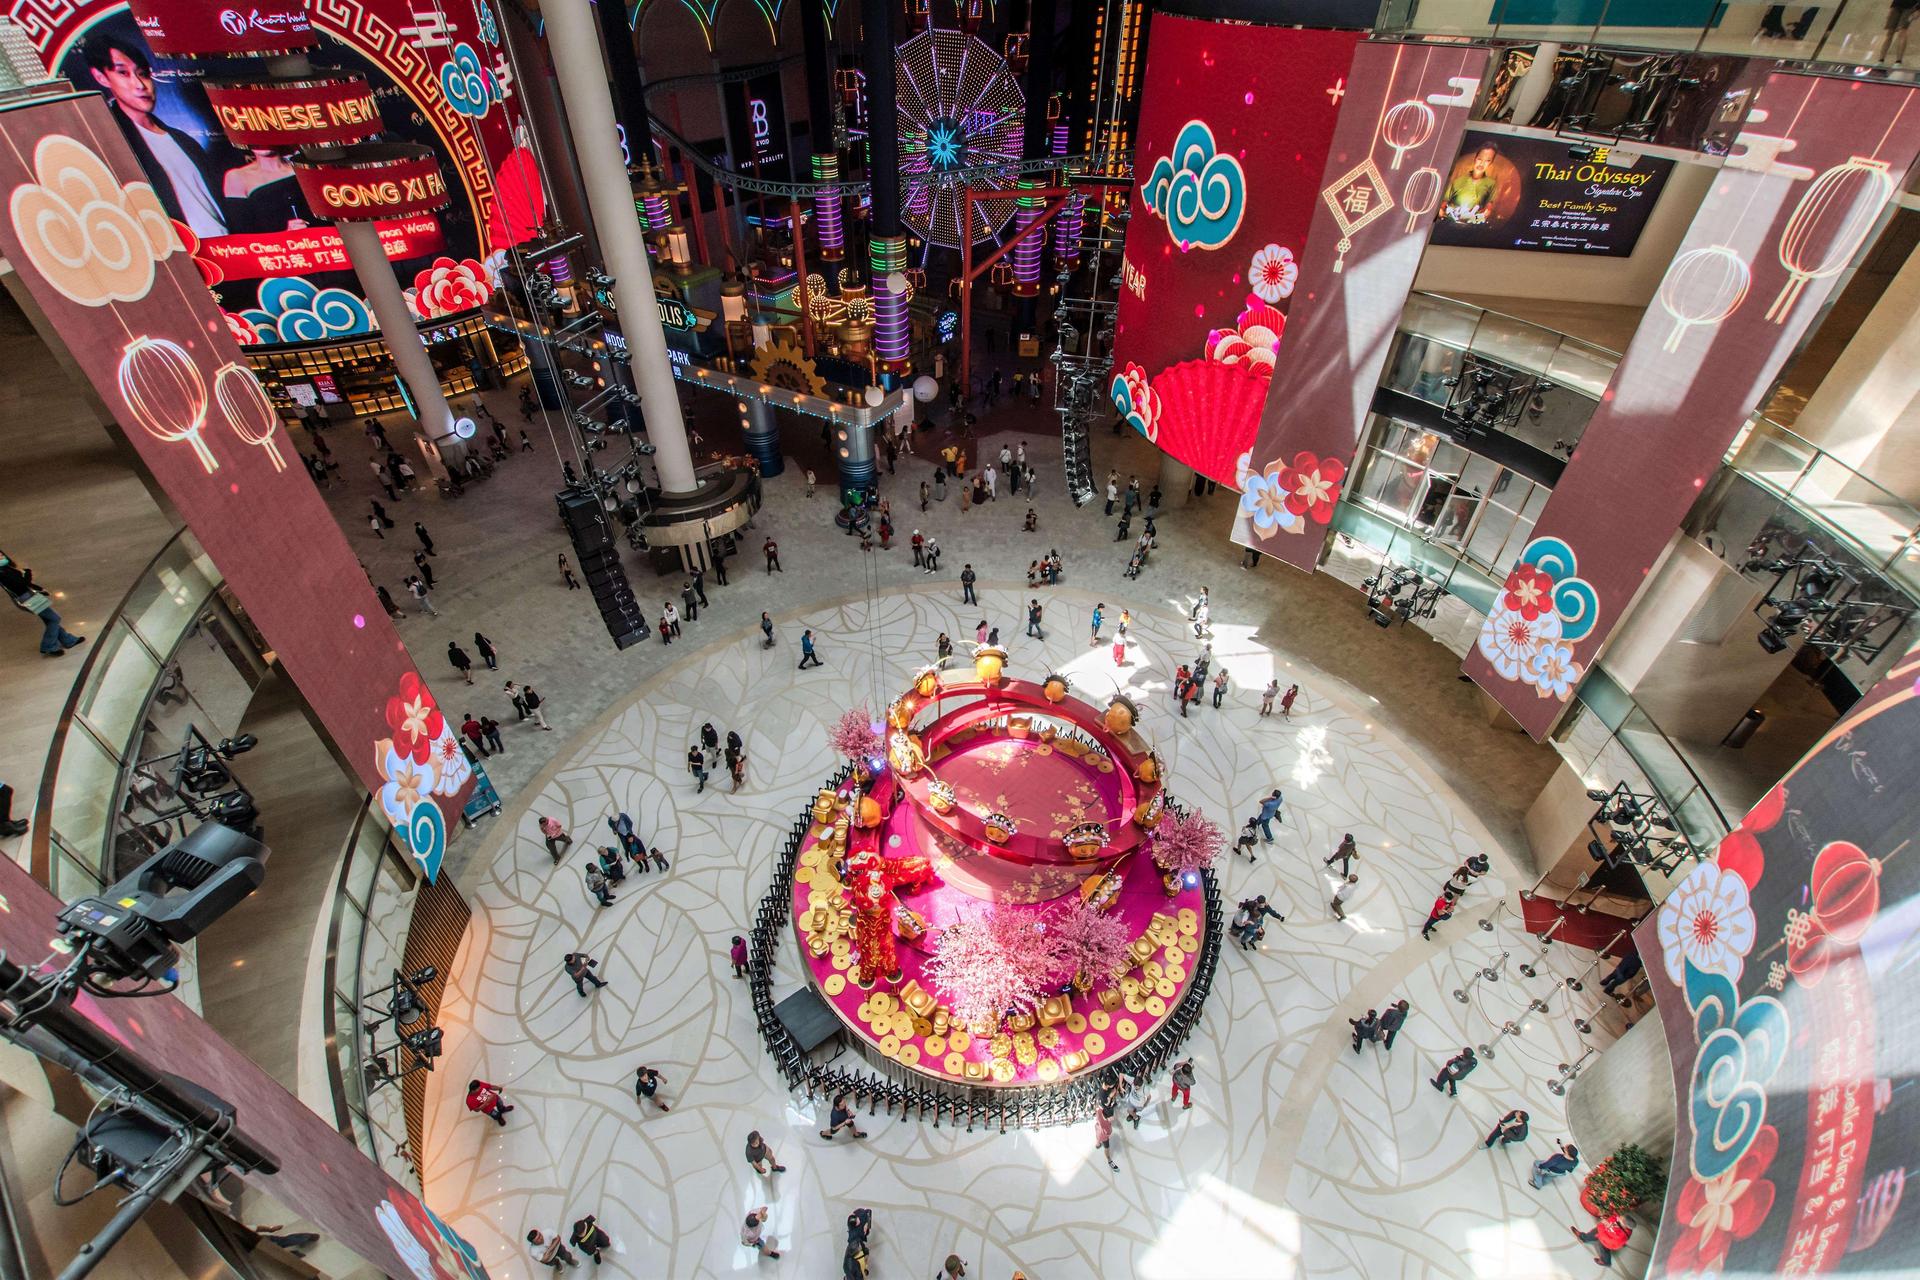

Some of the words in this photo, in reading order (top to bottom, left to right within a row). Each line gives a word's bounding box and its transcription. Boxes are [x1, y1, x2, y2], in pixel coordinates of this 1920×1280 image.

[222, 104, 327, 132] CHINESE
[327, 95, 374, 127] NEW
[1534, 162, 1574, 182] Thai
[1576, 164, 1654, 187] Odyssey
[322, 181, 402, 208] GONG
[402, 177, 427, 202] XI
[1343, 184, 1373, 215] 福
[1584, 183, 1623, 198] Signature
[1622, 185, 1644, 200] Spa
[1538, 199, 1562, 209] Best
[1563, 201, 1595, 213] Family
[1597, 203, 1618, 214] Spa
[321, 234, 345, 247] Din
[378, 227, 403, 240] rson
[402, 221, 436, 235] Wang
